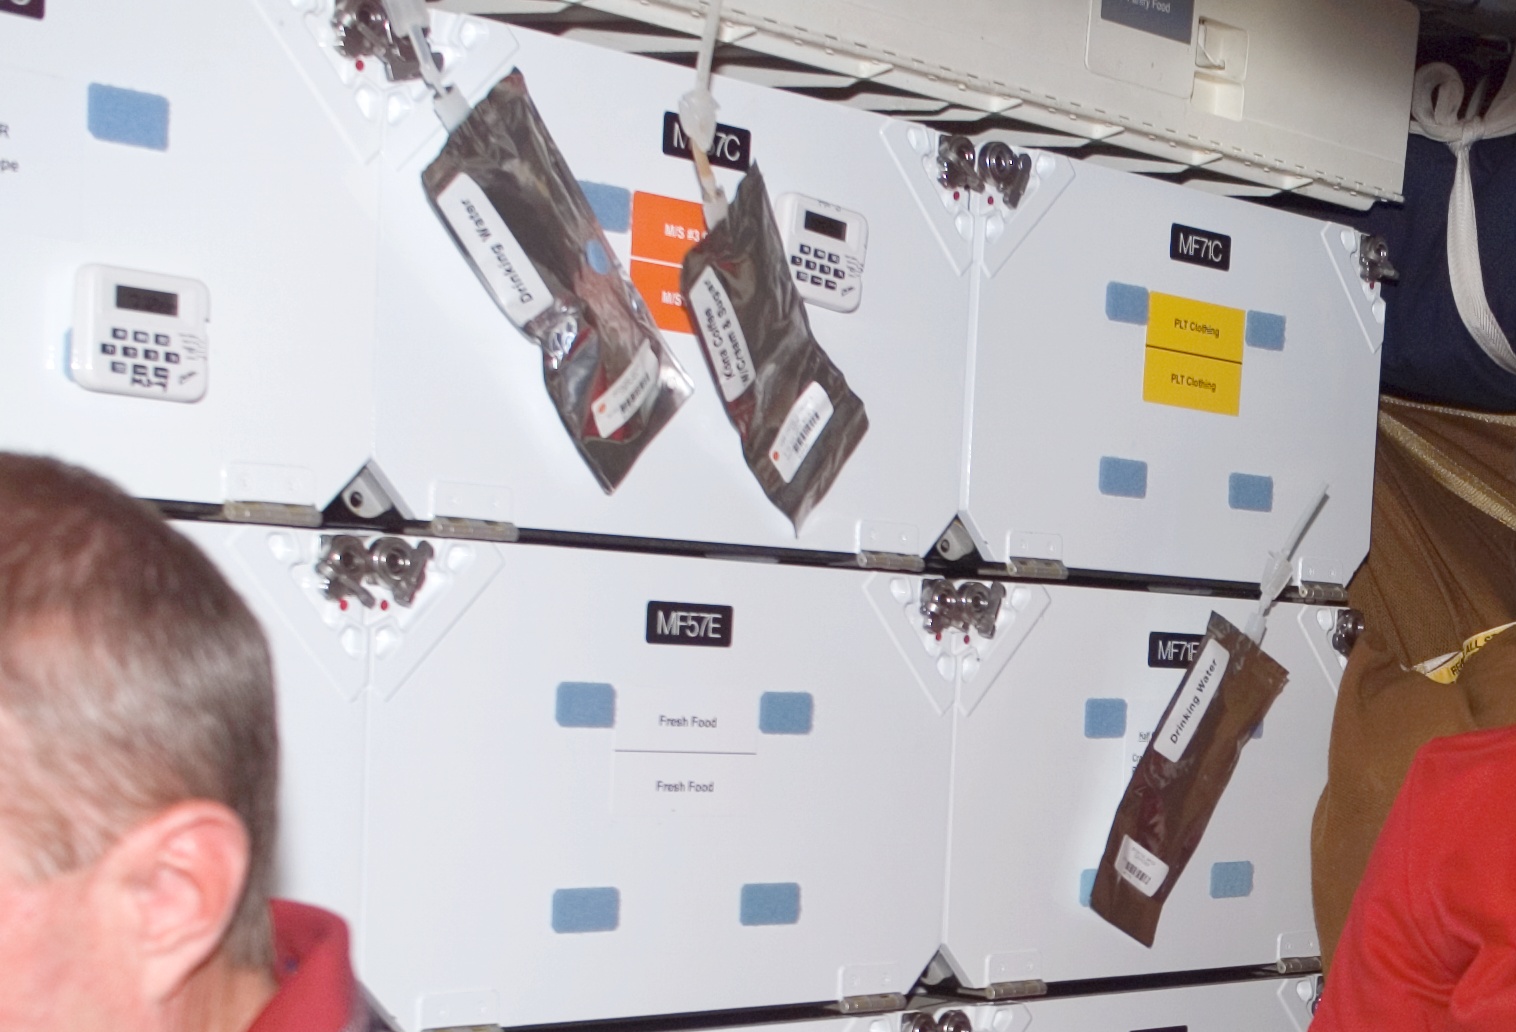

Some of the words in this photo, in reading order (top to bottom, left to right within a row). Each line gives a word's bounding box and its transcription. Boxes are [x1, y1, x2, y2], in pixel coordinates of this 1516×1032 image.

[1152, 0, 1171, 14] Food
[672, 121, 741, 162] M7C
[461, 199, 492, 243] Water
[664, 223, 685, 241] M/S
[1178, 232, 1223, 263] MF71C
[491, 243, 534, 304] Drinking
[703, 279, 728, 319] Sugar
[704, 306, 724, 348] Coffee
[1174, 317, 1189, 332] PLT
[1190, 321, 1220, 339] Clothing
[719, 349, 736, 381] Kona
[1171, 373, 1185, 386] PLT
[1186, 375, 1217, 393] Clothing
[656, 609, 722, 638] MF57E
[1169, 695, 1201, 745] Drinking
[1196, 658, 1219, 694] Water
[658, 715, 688, 728] Fresh
[690, 716, 718, 729] Food
[656, 780, 685, 793] Fresh
[687, 781, 714, 794] Food
